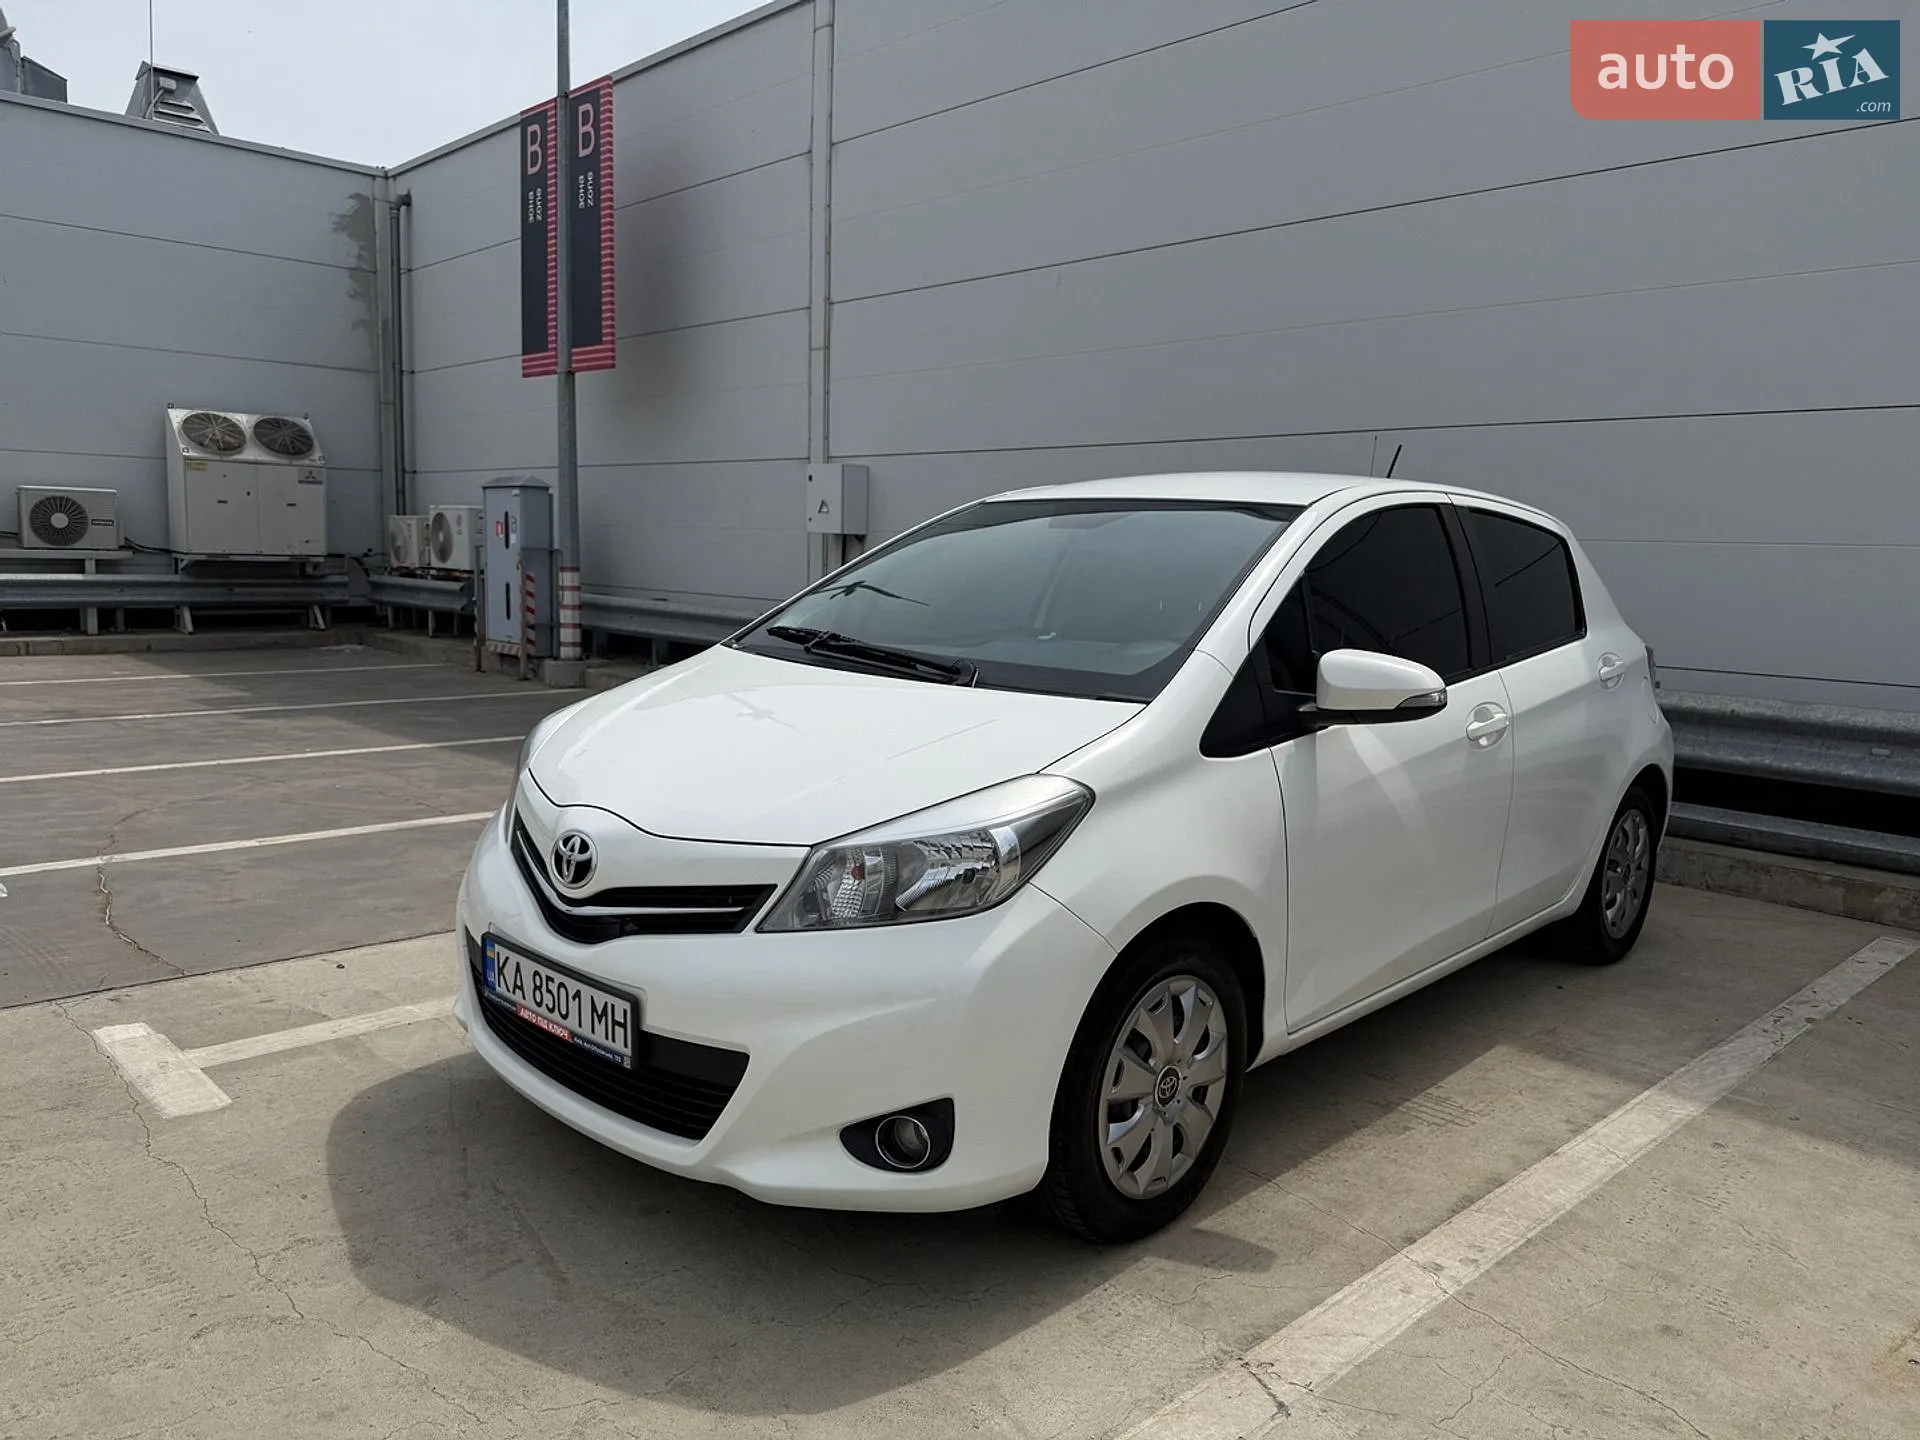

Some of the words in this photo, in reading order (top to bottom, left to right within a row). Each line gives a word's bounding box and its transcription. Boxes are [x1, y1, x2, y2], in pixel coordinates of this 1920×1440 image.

[527, 123, 543, 176] B
[578, 102, 595, 159] B
[497, 952, 526, 1000] KA
[533, 970, 582, 1028] 8501
[591, 996, 627, 1049] MH
